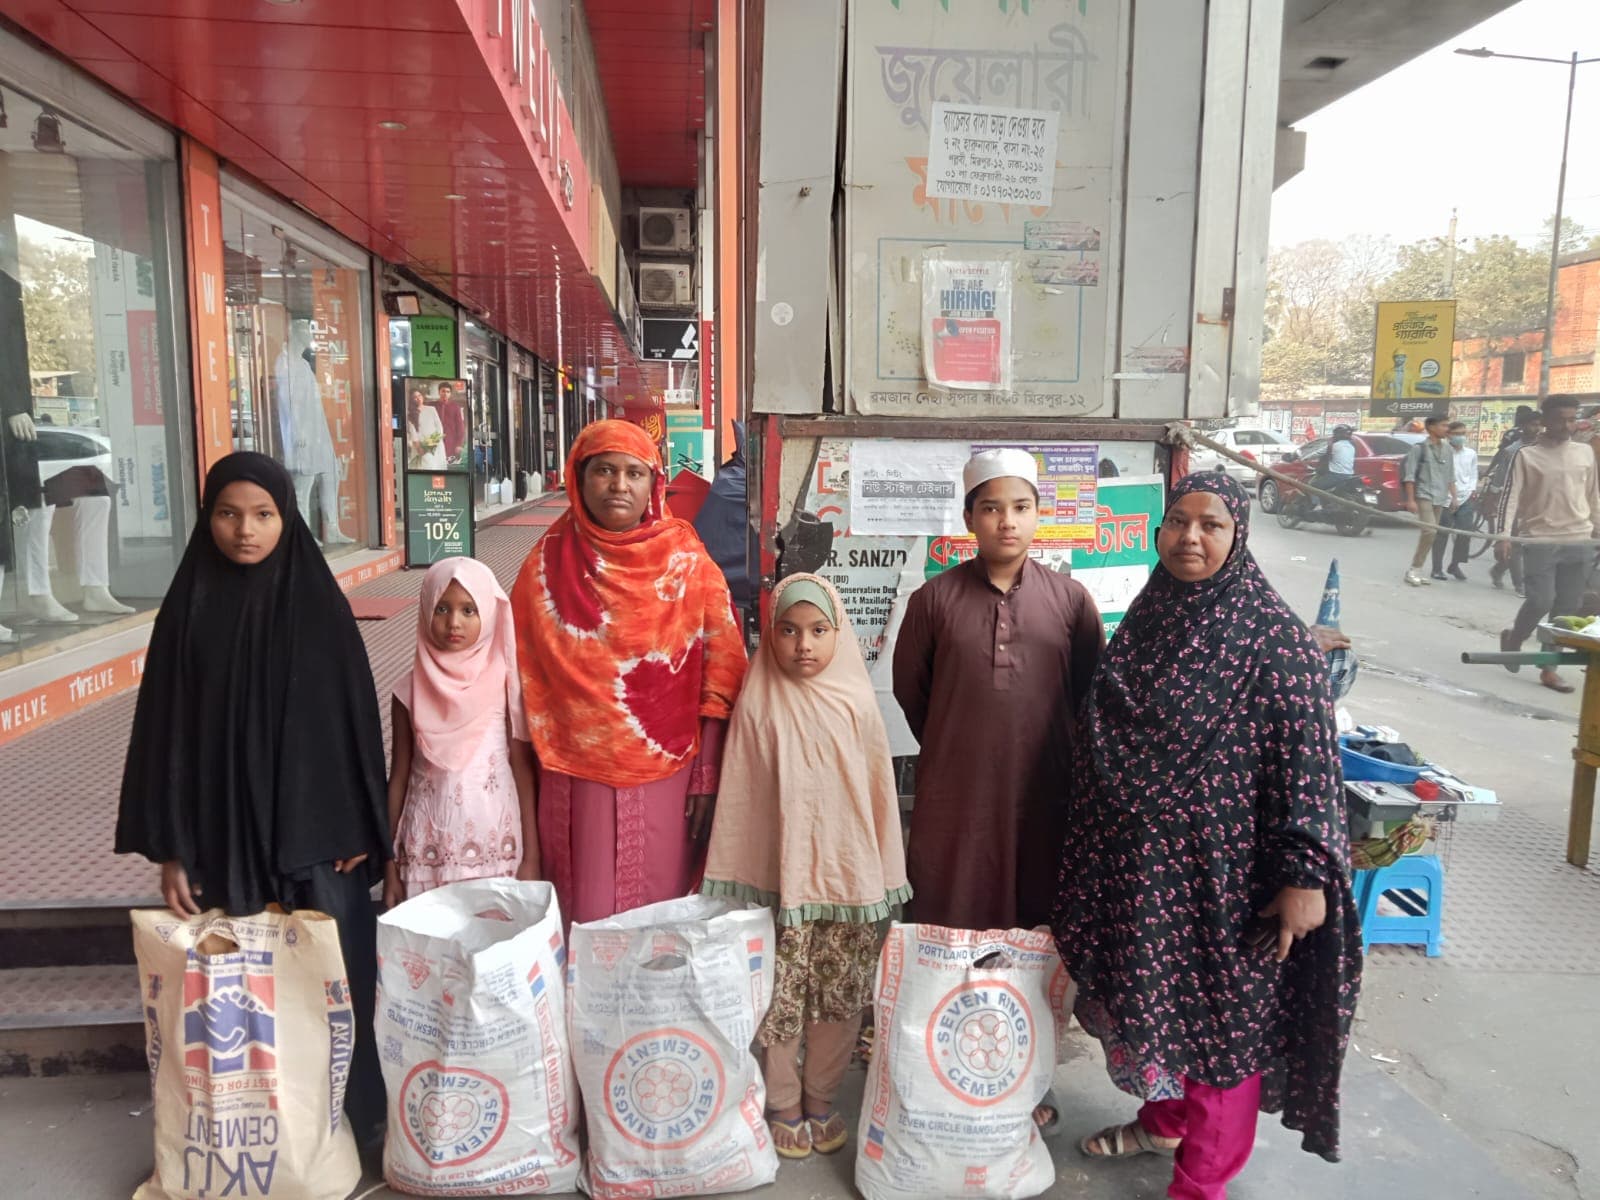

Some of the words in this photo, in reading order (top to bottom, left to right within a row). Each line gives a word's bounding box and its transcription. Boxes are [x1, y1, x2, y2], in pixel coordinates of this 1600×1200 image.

[973, 113, 989, 135] বাসা
[1032, 118, 1047, 140] হবে
[952, 279, 965, 290] WE
[940, 289, 997, 311] HIRING!
[201, 204, 222, 447] TWEL
[422, 340, 443, 358] 14
[1400, 402, 1434, 410] BSRM
[863, 480, 881, 493] নিউ
[883, 481, 913, 494] স্টাইল
[424, 522, 460, 540] 10%
[833, 574, 849, 584] (DU)
[0, 694, 48, 732] WELVE
[69, 668, 114, 703] TWELVE
[919, 924, 967, 943] SEVEN
[881, 926, 903, 998] SPECIAL
[918, 943, 969, 961] PORTLAND
[937, 992, 988, 1043] SEVEN
[998, 993, 1028, 1046] RINGS
[330, 1021, 352, 1059] AKIJ
[461, 1035, 495, 1050] CIRCLE
[625, 1038, 701, 1068] CEMENT
[227, 1079, 249, 1091] FOR
[418, 1069, 481, 1091] CEMENT
[547, 1057, 561, 1104] RINGS
[948, 1067, 1016, 1097] CEMENT
[612, 1084, 659, 1140] RINGS
[666, 1078, 714, 1140] SEVEN
[184, 1112, 279, 1149] CEMENT
[406, 1101, 445, 1162] RINGS
[454, 1097, 498, 1157] SEVEN
[898, 1115, 926, 1129] SEVEN
[928, 1119, 961, 1133] CIRCLE
[183, 1146, 278, 1198] AKIJ
[483, 1159, 541, 1184] PORTLAND
[495, 1174, 546, 1194] SEVEN
